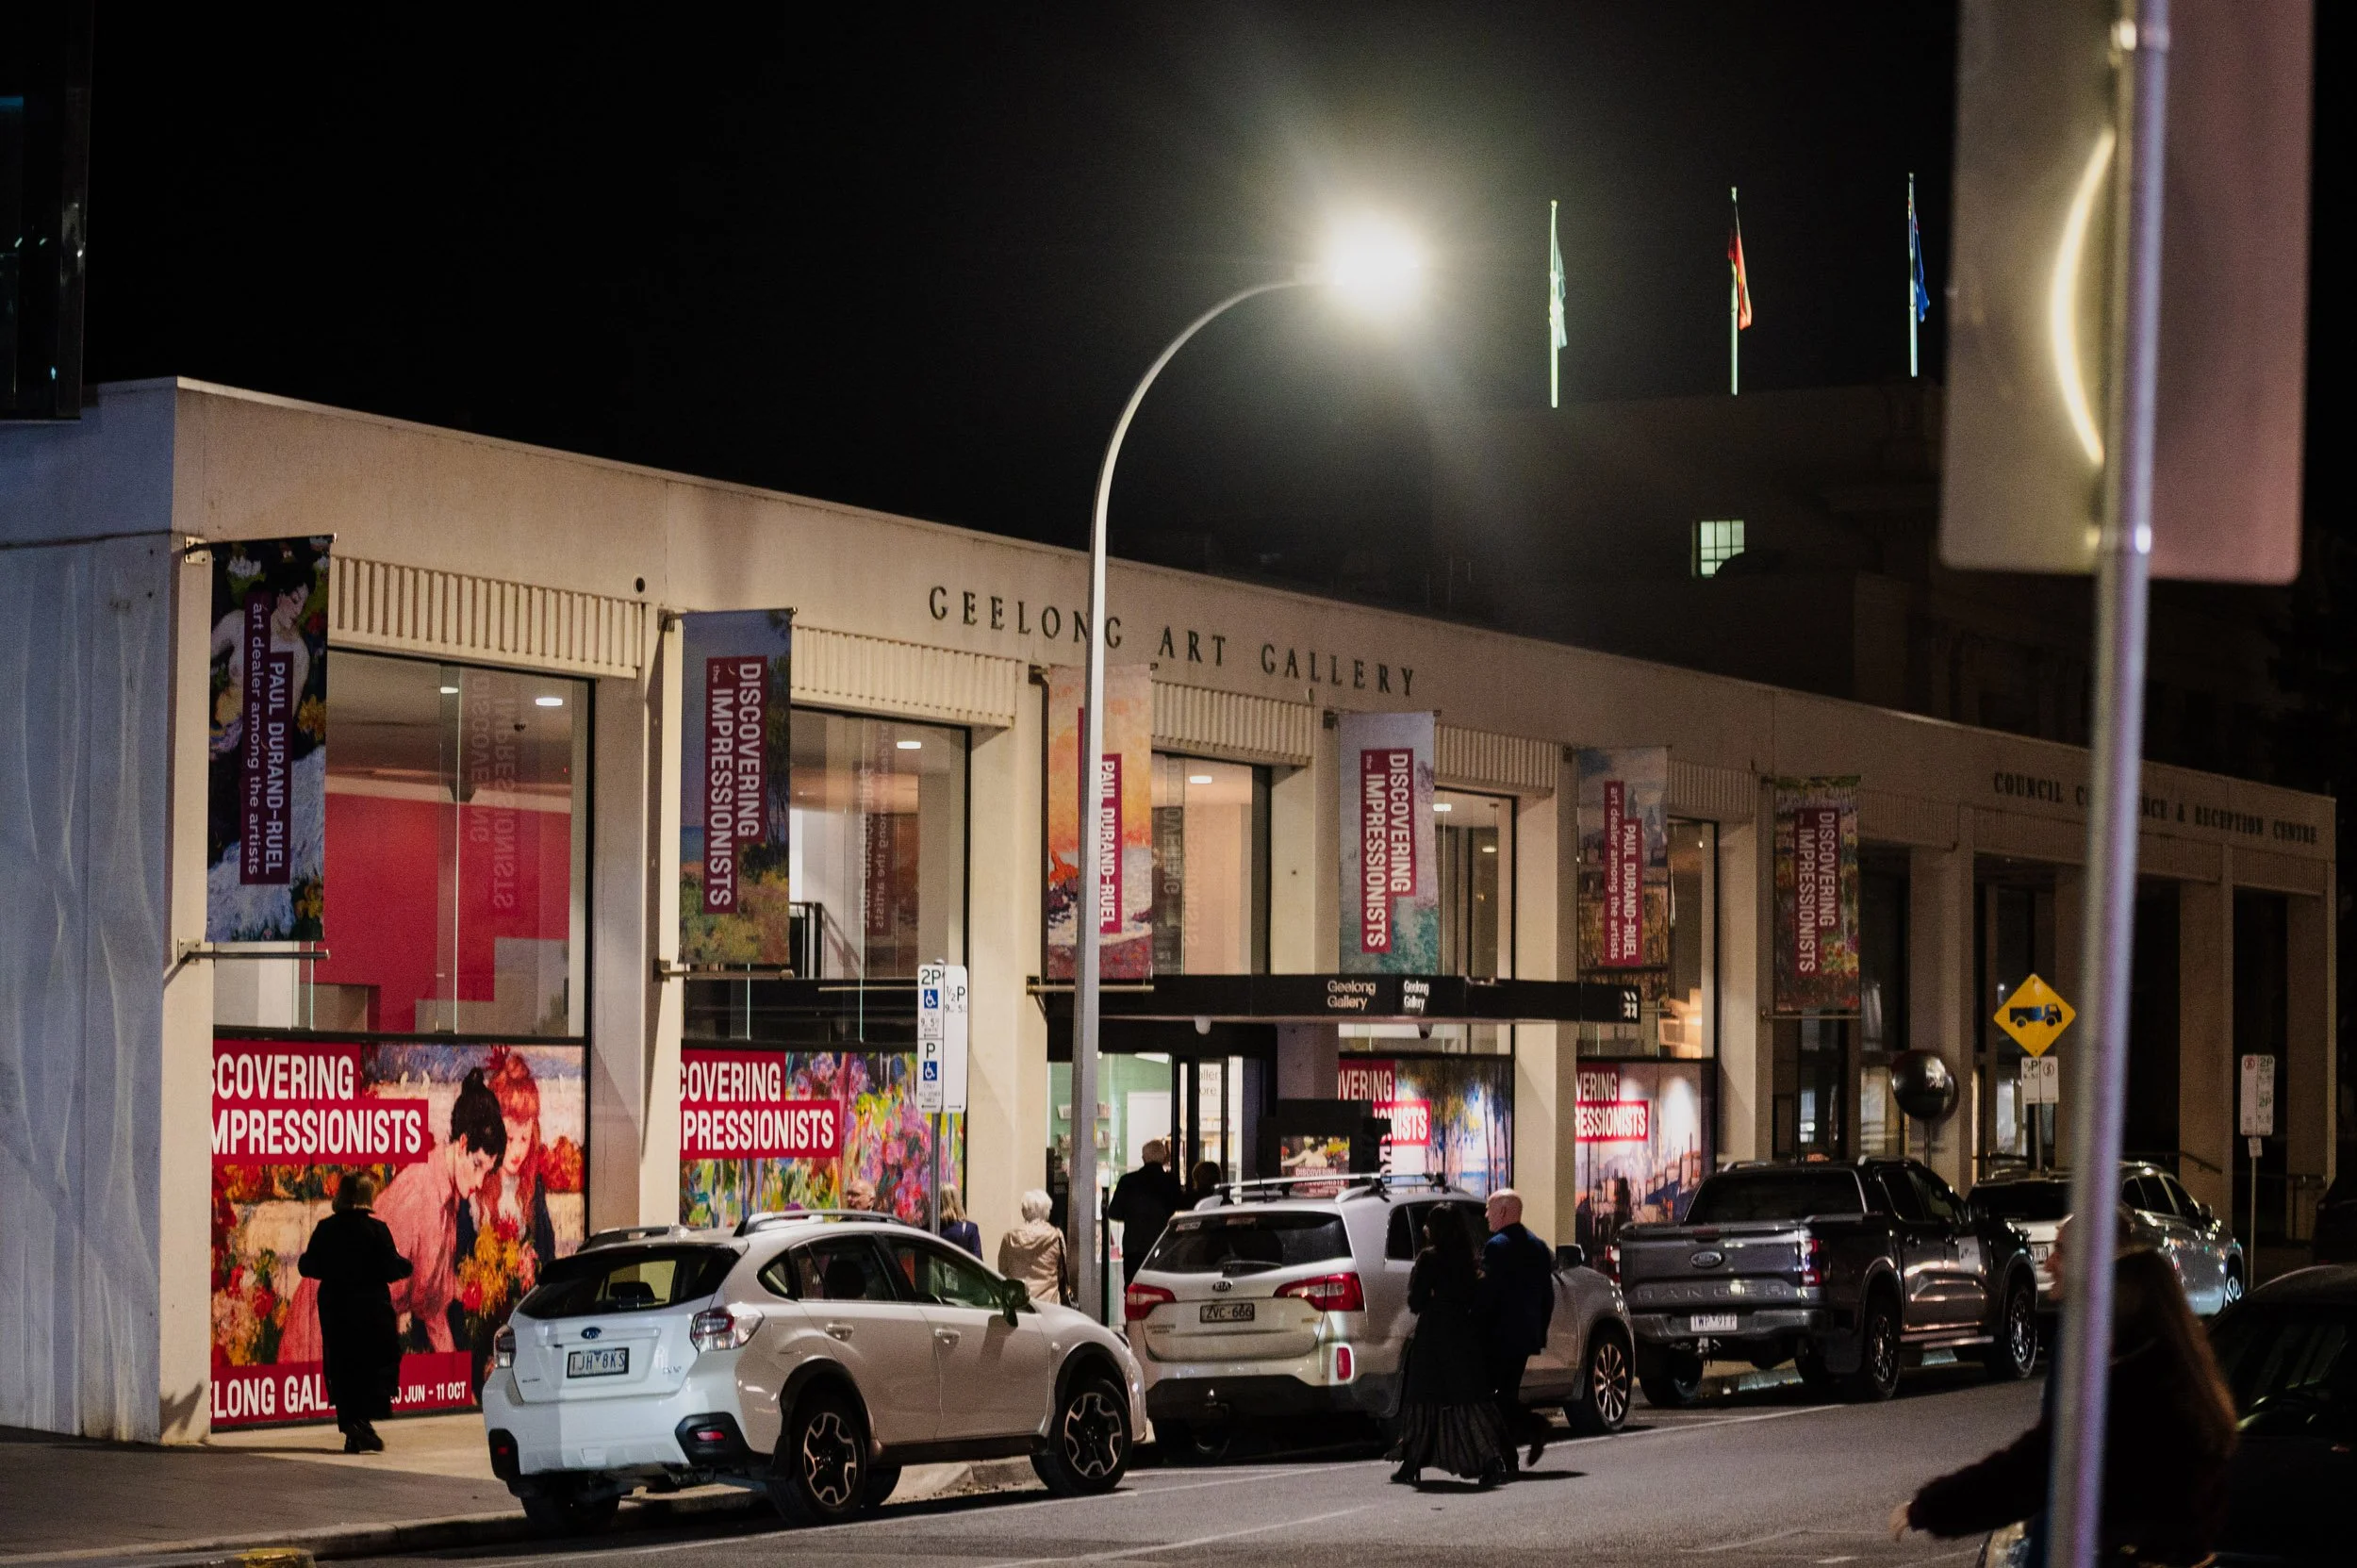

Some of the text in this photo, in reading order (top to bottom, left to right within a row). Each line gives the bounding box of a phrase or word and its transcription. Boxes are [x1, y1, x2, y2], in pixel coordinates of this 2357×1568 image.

[929, 586, 1414, 697] GEELONG ART GALLERY
[246, 602, 263, 875] art dealer among the artists
[737, 662, 762, 837] DISCOVERING
[265, 662, 287, 875] PAUL DURAND-RUEL
[1993, 771, 2064, 804] COUNCIL
[709, 688, 733, 906] IMPRESSIONISTS
[1389, 752, 1411, 892] DISCOVERING
[1609, 807, 1619, 848] dealer
[2194, 805, 2264, 835] RECEPTION
[2272, 821, 2317, 845] CENTRE
[1099, 761, 1115, 927] PAUL DURAND-RUEL
[1366, 774, 1387, 947] IMPRESSIONISTS
[1607, 850, 1618, 893] among
[1819, 812, 1835, 926] DISCOVERING
[1609, 895, 1619, 917] the
[1624, 824, 1636, 960] PAUL DURAND-RUEL
[1799, 829, 1816, 973] IMPRESSIONISTS
[1609, 919, 1619, 960] artists
[921, 968, 941, 985] 2P
[1327, 980, 1376, 996] Geelong
[1404, 980, 1429, 996] Geelong
[1327, 995, 1367, 1011] Gallery
[1404, 995, 1426, 1011] Gallery
[926, 1042, 936, 1059] P
[680, 1109, 834, 1151] PRESSIONISTS
[210, 1373, 337, 1419] LONG GAL
[404, 1384, 425, 1403] JUN
[436, 1382, 445, 1402] 11
[447, 1380, 467, 1400] OCT
